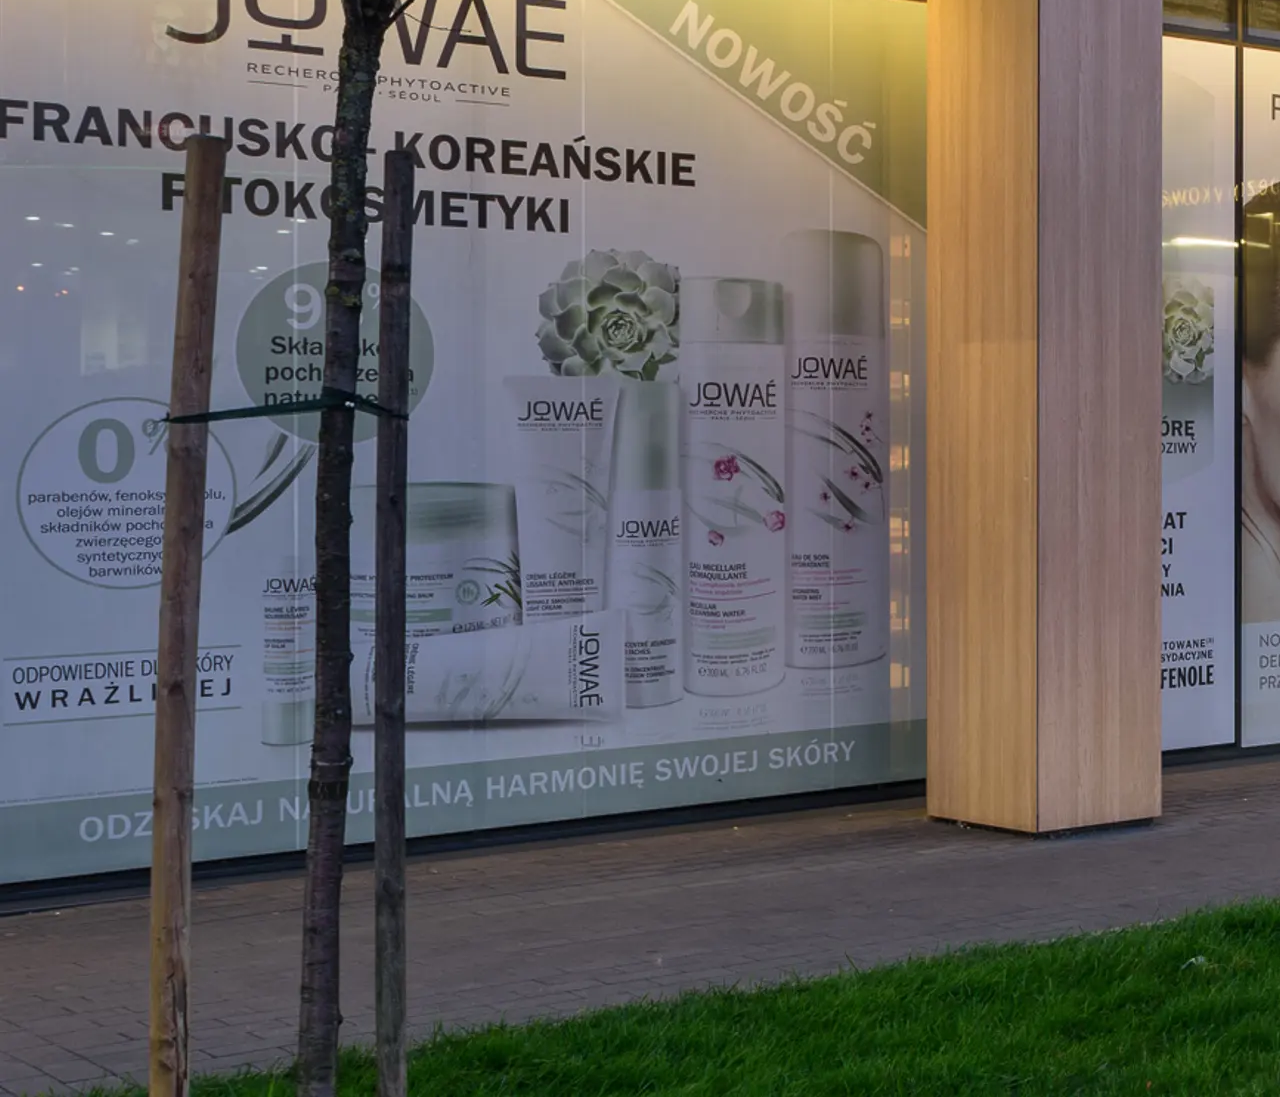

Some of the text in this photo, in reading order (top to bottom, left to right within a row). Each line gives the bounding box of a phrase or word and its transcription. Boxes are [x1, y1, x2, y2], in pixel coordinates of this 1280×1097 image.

[247, 62, 511, 97] RECHERC PHYTOACTIVE
[668, 0, 877, 165] NOWOŚĆ
[394, 131, 696, 187] KOREAŃSKIE
[791, 355, 868, 380] JOWAÉ
[690, 379, 777, 408] JOWAÉ
[517, 397, 604, 422] JOWAÉ
[28, 490, 112, 505] parabenów,
[57, 505, 103, 519] olejów
[40, 521, 121, 534] składników
[616, 516, 680, 539] JOWAÉ
[12, 660, 135, 685] ODPOWIEDNIE
[579, 624, 604, 708] JOWAÉ
[14, 678, 232, 711] WRAŻLIEJ
[486, 761, 645, 800] HARMONIĘ
[655, 750, 759, 782] SWOJEJ
[768, 738, 856, 770] SKÓRY
